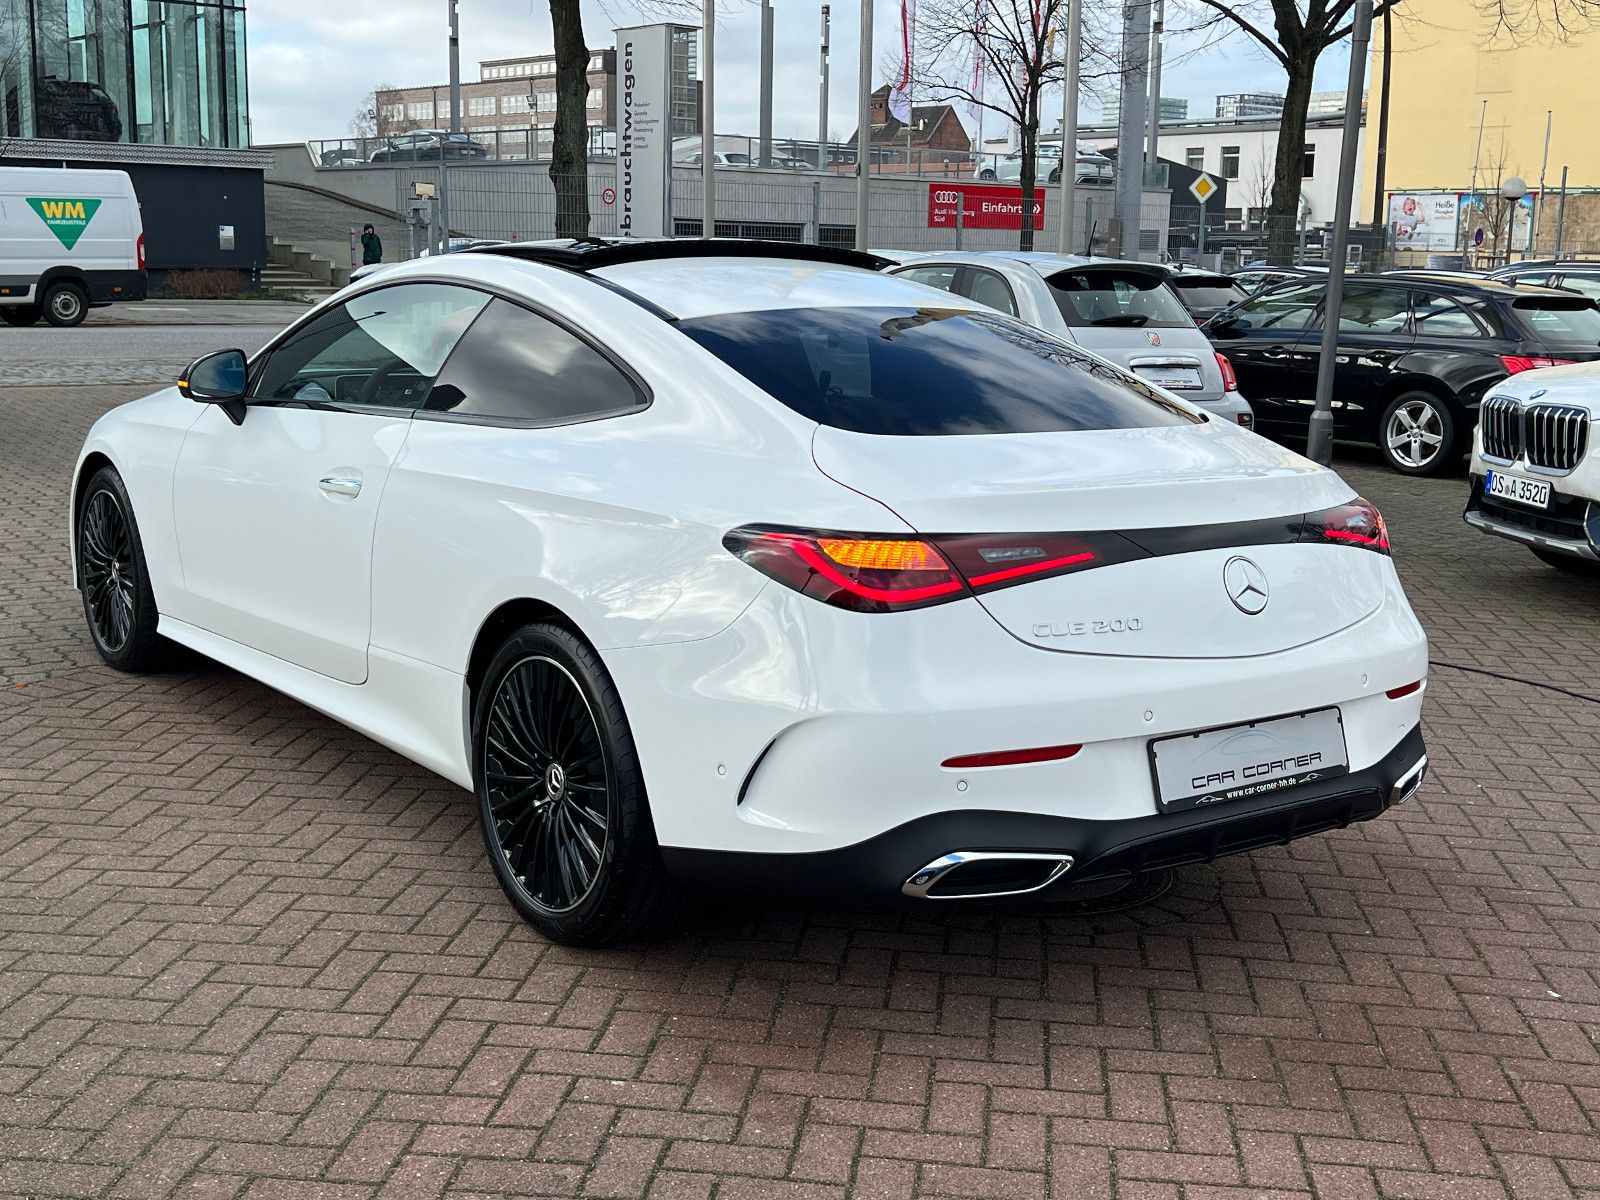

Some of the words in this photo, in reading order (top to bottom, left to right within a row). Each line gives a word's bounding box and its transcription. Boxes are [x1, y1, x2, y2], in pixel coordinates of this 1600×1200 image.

[42, 201, 86, 219] WM
[982, 202, 1023, 214] Einfahrt
[1491, 473, 1505, 493] OS
[1510, 479, 1517, 497] A
[1519, 481, 1548, 504] 3520
[1033, 622, 1086, 638] CLE
[1092, 617, 1144, 634] 200
[1191, 769, 1236, 790] CAR
[1242, 751, 1323, 779] CORNER
[1226, 776, 1298, 800] www.car-corner-hh.de
